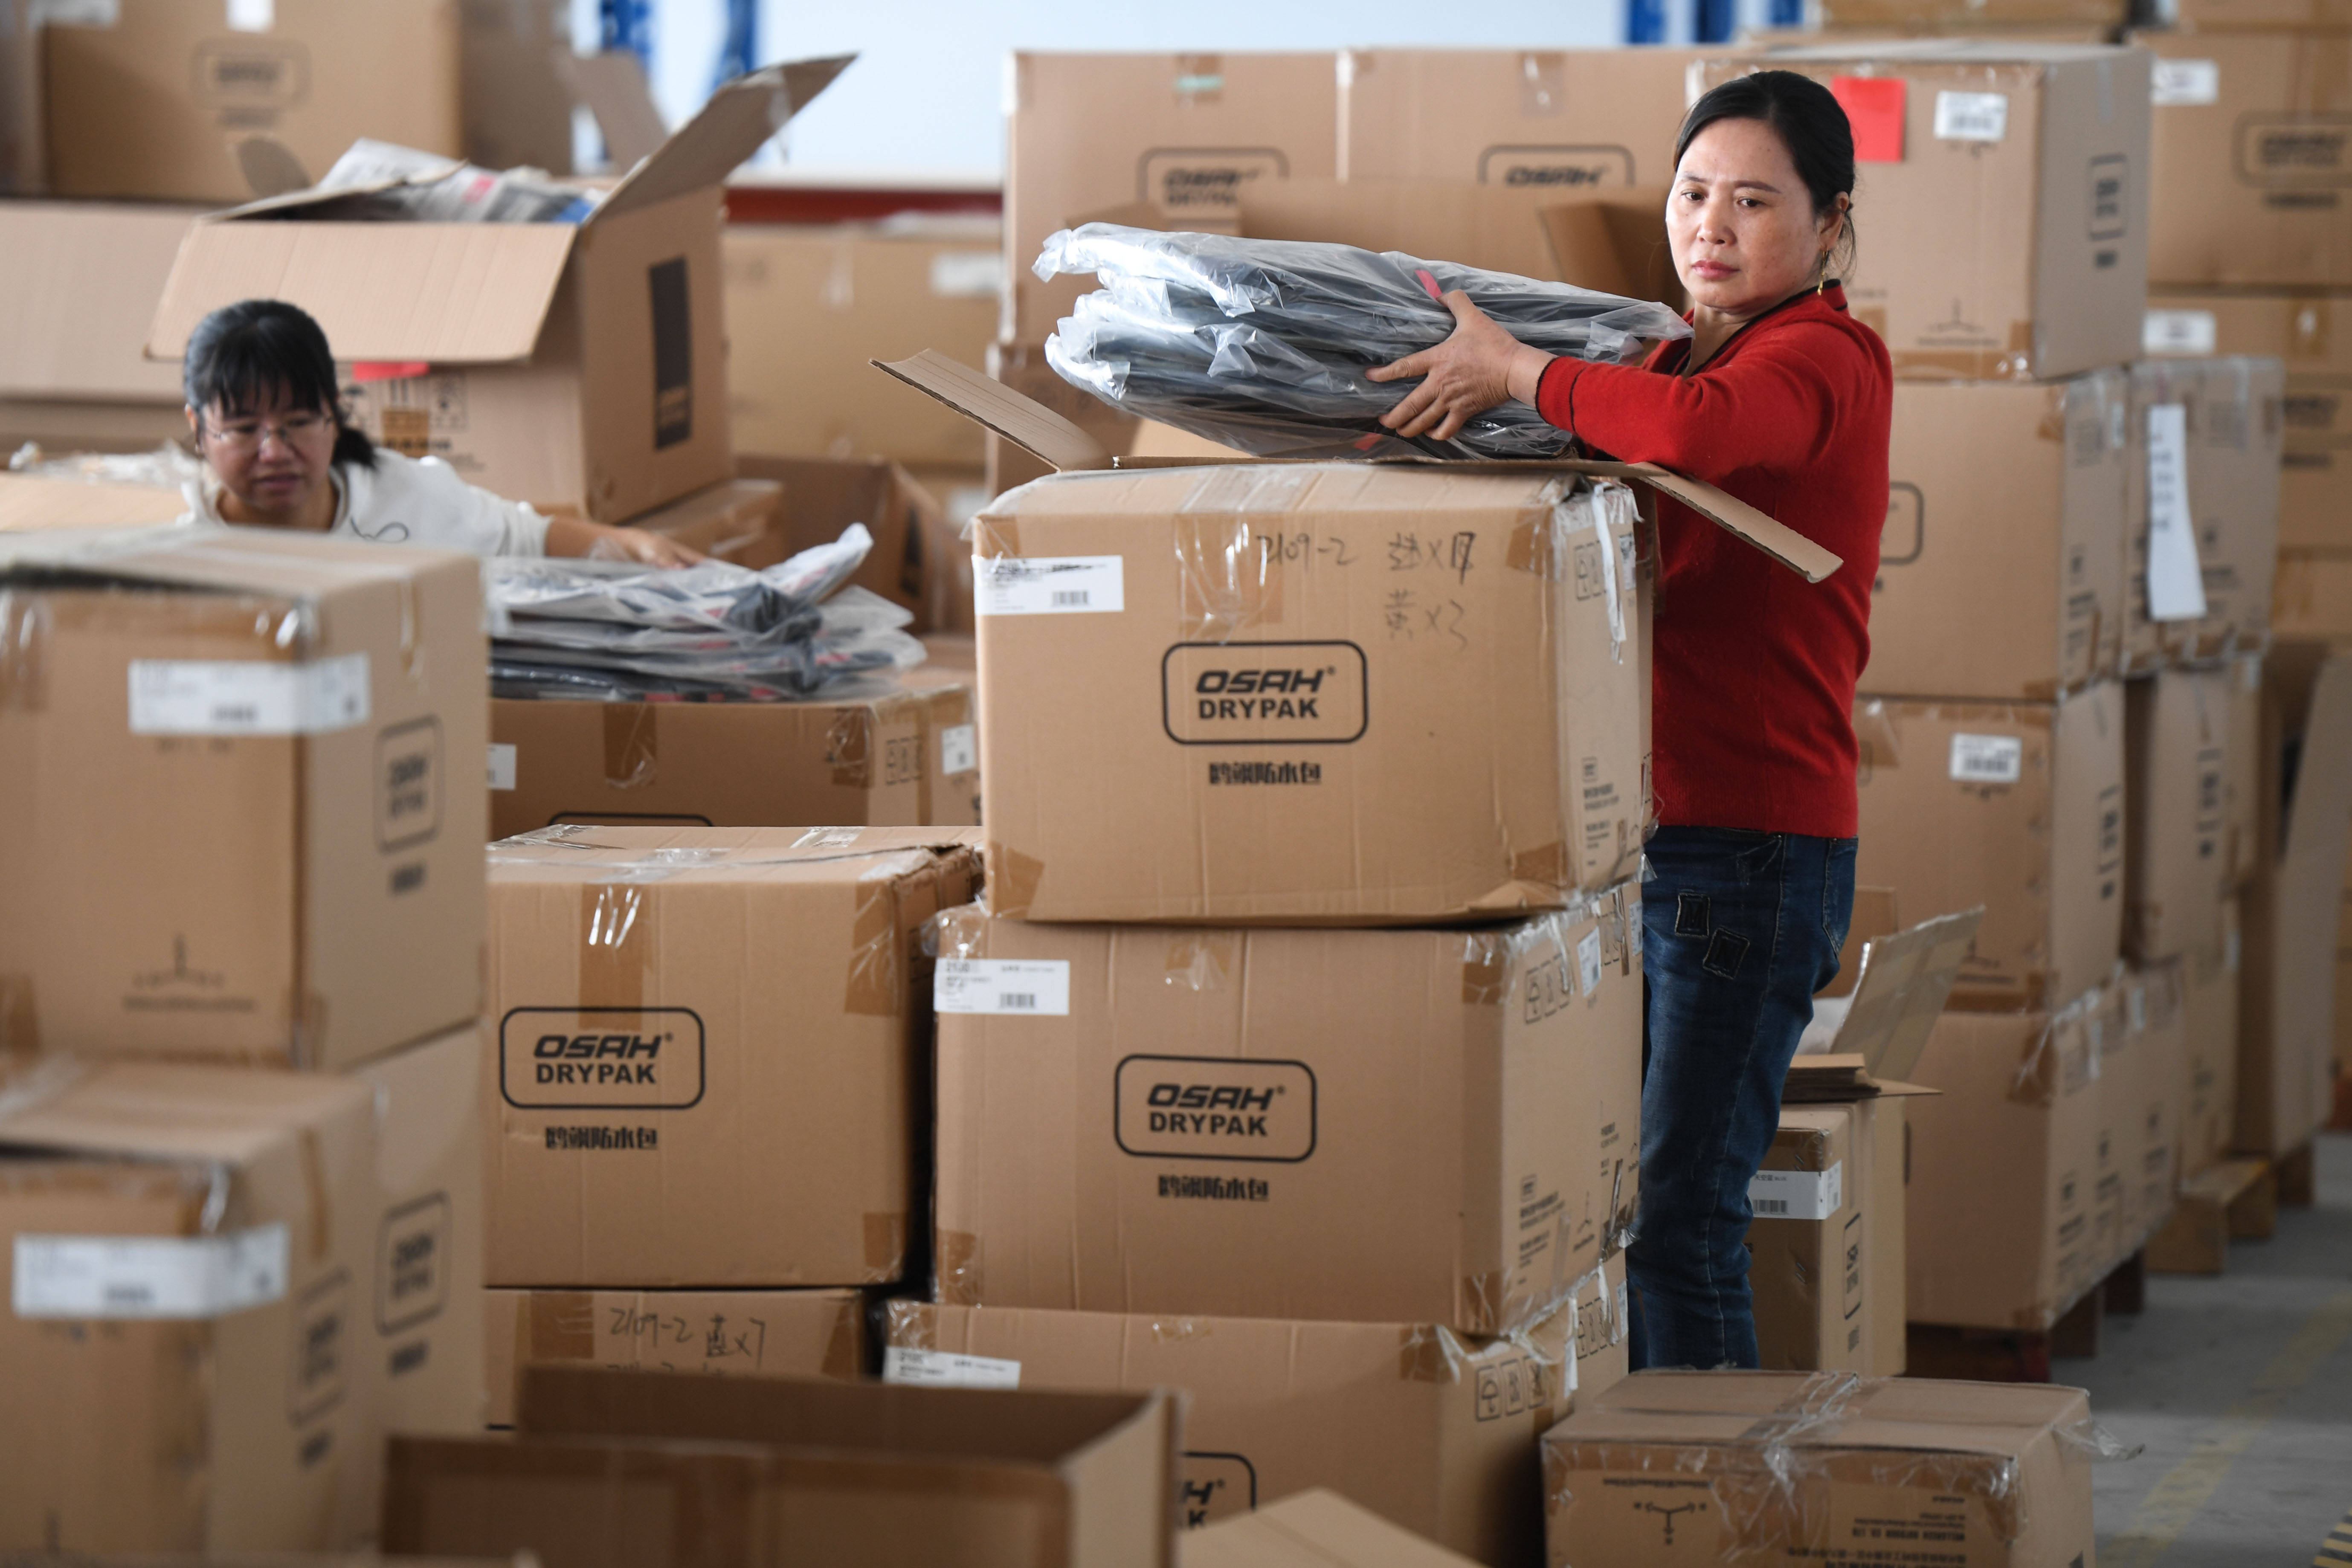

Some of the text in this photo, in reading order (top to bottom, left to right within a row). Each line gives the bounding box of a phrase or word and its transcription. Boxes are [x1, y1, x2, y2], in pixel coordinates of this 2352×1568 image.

[1196, 669, 1325, 694] OSAH
[1198, 698, 1319, 719] DRYPAK
[533, 1035, 662, 1059] OSAH
[536, 1063, 657, 1084] DRYPAK
[1147, 1083, 1275, 1111] OSAH
[1149, 1112, 1268, 1137] DRYPAK
